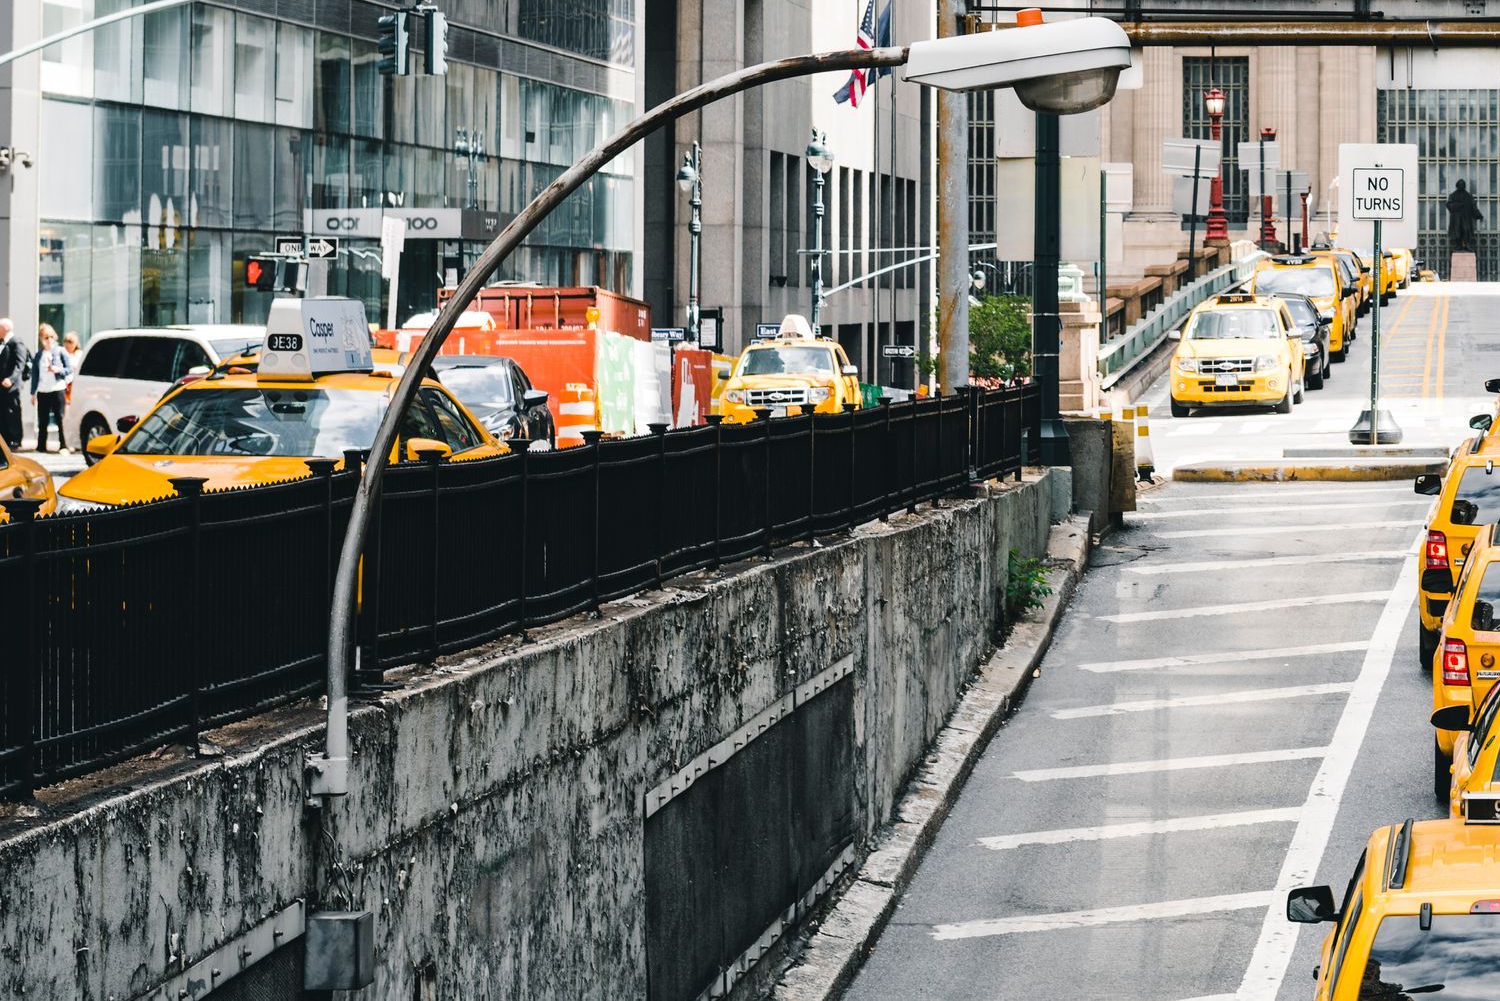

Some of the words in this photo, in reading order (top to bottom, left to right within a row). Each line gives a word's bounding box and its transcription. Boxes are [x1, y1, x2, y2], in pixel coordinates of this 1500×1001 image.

[1367, 177, 1388, 191] NO
[1355, 197, 1401, 210] TURNS
[406, 217, 438, 230] 100
[310, 244, 328, 252] WAY
[309, 317, 335, 344] Casper
[760, 327, 777, 335] East
